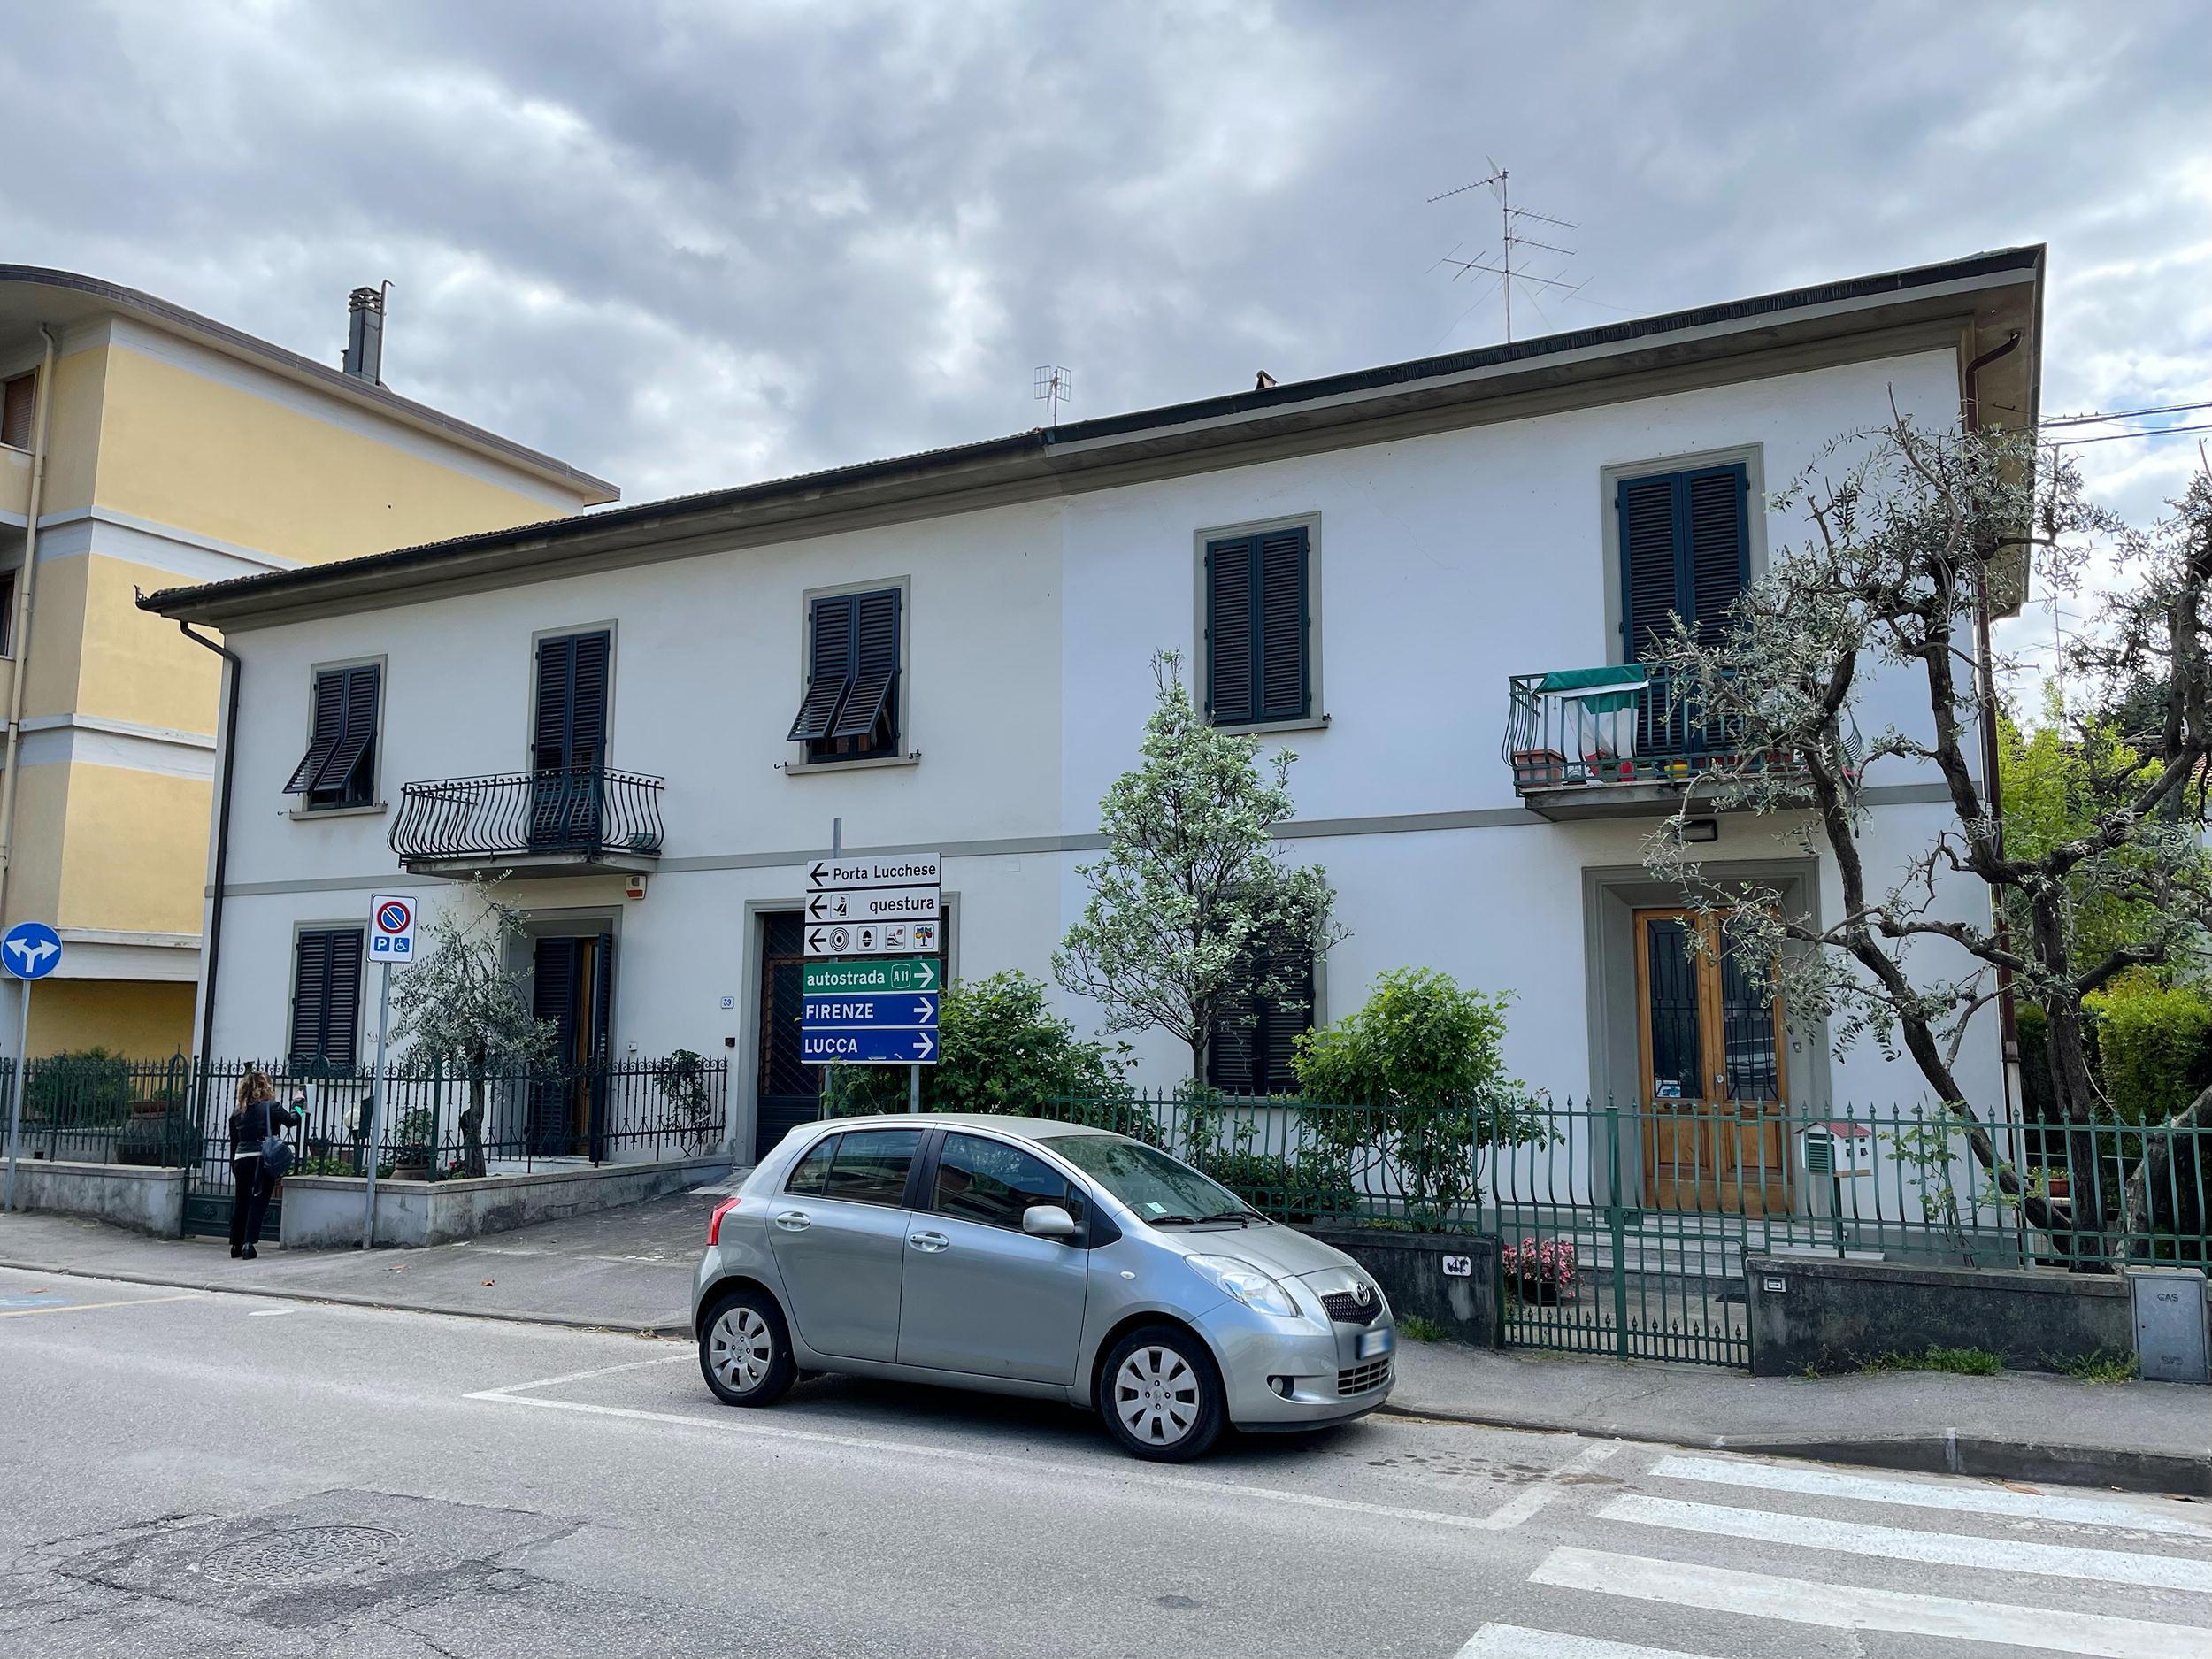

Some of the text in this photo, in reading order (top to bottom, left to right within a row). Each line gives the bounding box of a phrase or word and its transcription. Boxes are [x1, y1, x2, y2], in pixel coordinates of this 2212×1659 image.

[833, 863, 936, 880] Porta Lucchese
[870, 896, 934, 914] questura
[378, 938, 388, 949] P
[807, 969, 885, 986] autostrada
[806, 1002, 874, 1019] FIRENZE
[804, 1038, 858, 1054] LUCCA
[2157, 1293, 2178, 1302] GAS
